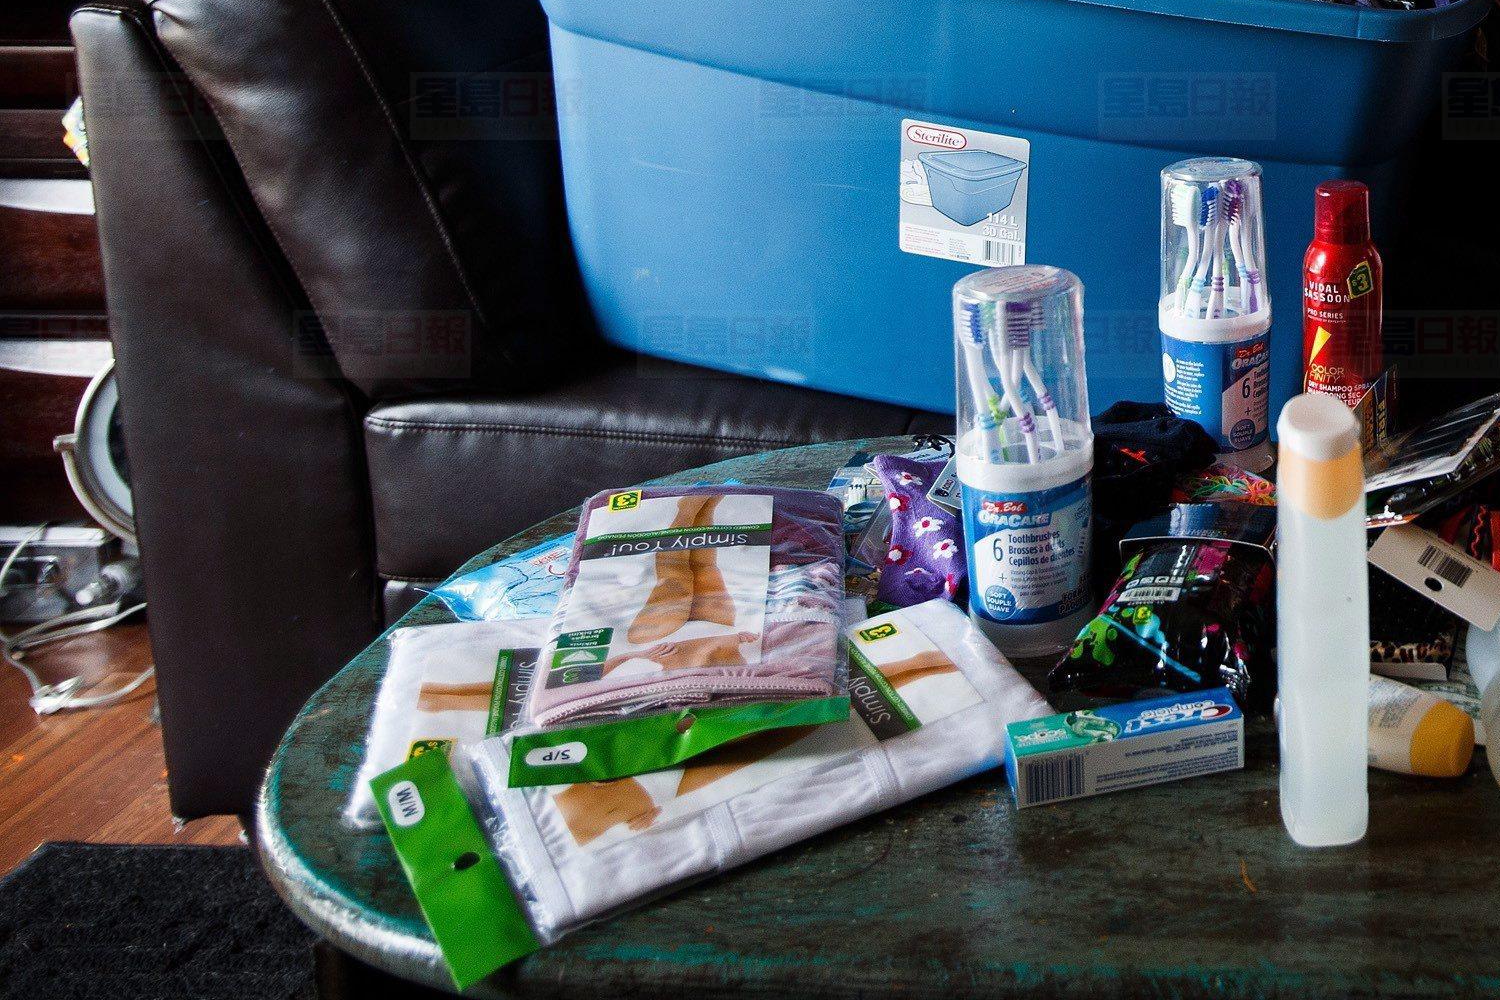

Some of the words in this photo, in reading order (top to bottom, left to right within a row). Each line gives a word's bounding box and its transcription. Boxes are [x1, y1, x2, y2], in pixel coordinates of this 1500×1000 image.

[914, 128, 960, 147] Sterilite
[987, 213, 1007, 225] 114
[1009, 217, 1019, 227] L
[982, 226, 997, 238] 30
[1309, 281, 1339, 294] VIDAL
[1304, 287, 1350, 303] SASSOON
[1307, 308, 1318, 317] PRO
[1319, 310, 1344, 320] SERIES
[1311, 363, 1344, 375] COLOR
[1309, 371, 1340, 384] FINITY
[1242, 377, 1251, 399] 6
[1308, 380, 1319, 389] DRY
[1320, 384, 1353, 393] SHAMPOO
[1008, 530, 1060, 544] Toothbrushes
[612, 540, 661, 557] You!
[992, 537, 1004, 561] 6
[1008, 544, 1038, 555] Brosses
[1008, 556, 1039, 568] Cepillos
[1040, 554, 1049, 564] de
[541, 748, 571, 762] S/P
[396, 787, 419, 818] M/M
